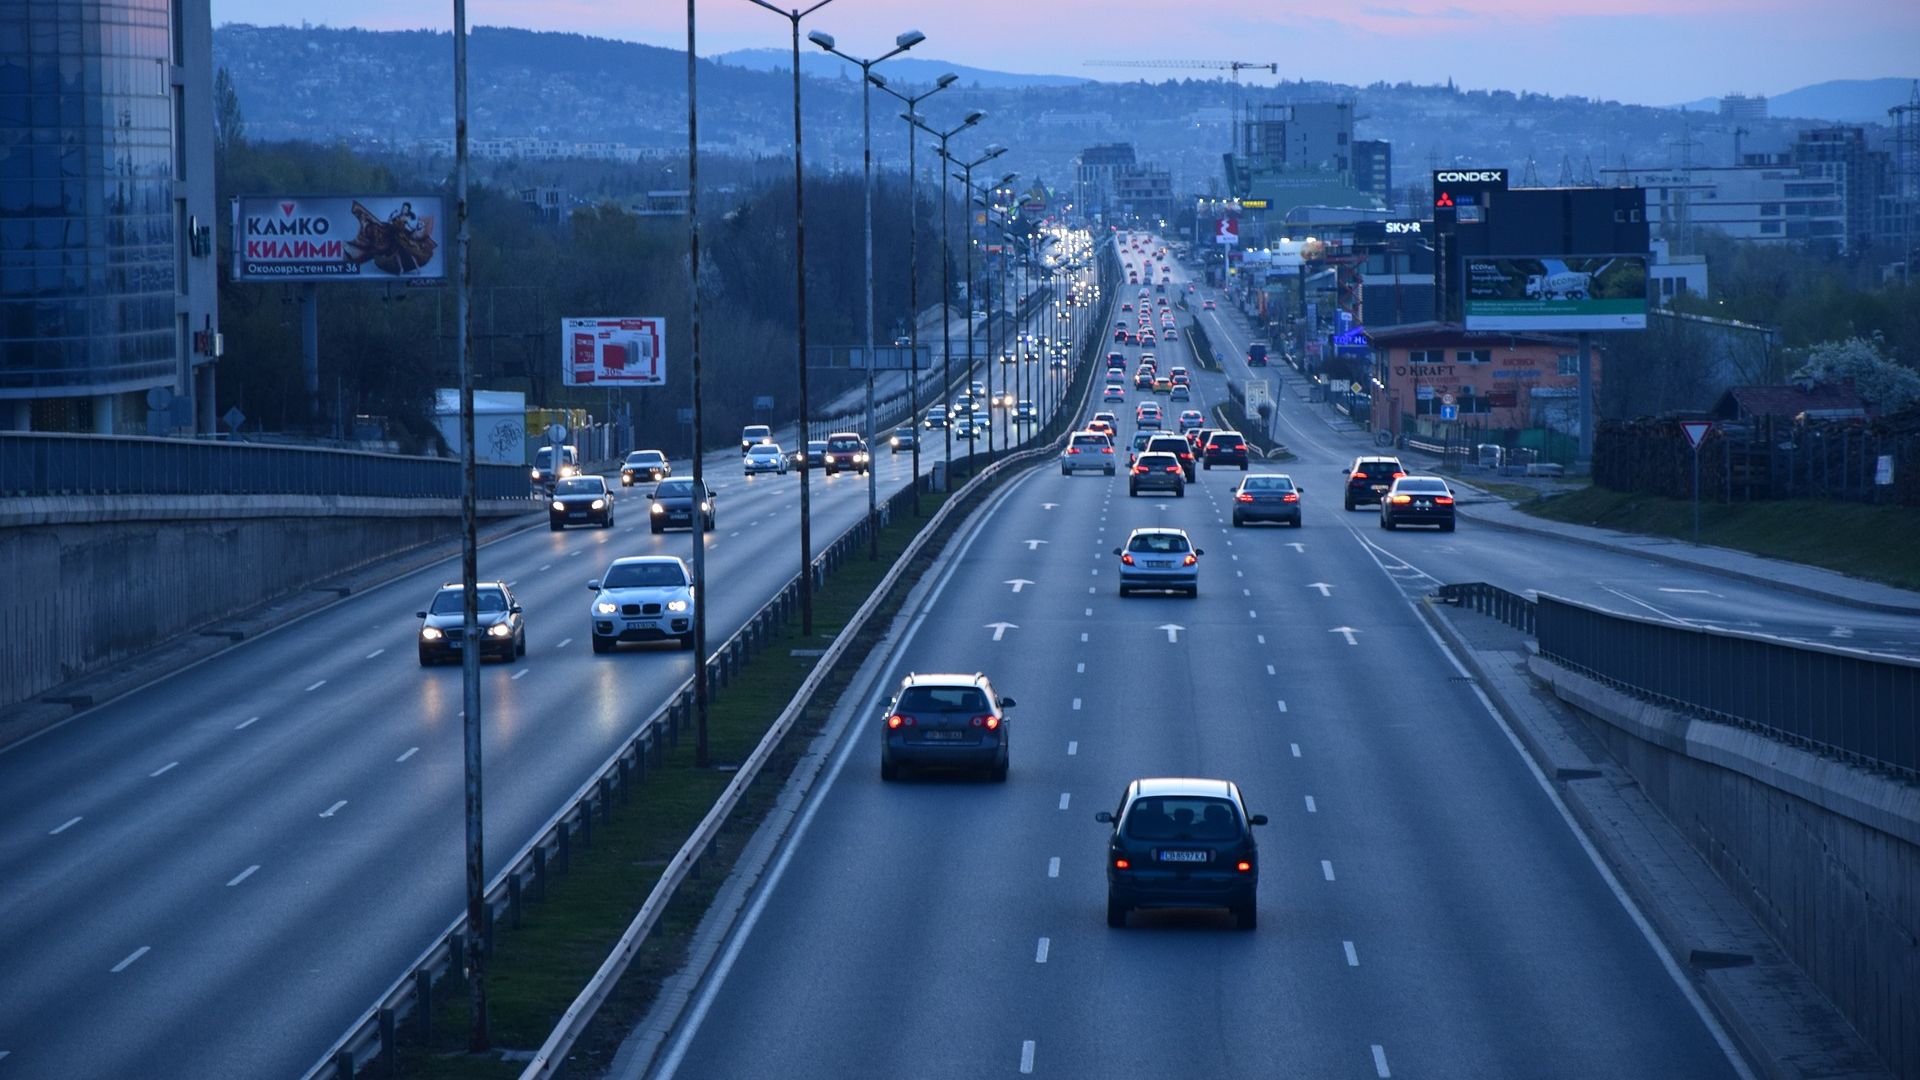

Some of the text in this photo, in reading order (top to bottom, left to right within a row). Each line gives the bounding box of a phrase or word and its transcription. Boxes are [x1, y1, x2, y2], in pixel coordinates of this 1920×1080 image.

[1437, 171, 1501, 182] CONDEX
[248, 217, 329, 235] КАМКО
[248, 240, 342, 258] КИЛИМИ
[248, 263, 357, 275] Околовръстен път 36
[1410, 365, 1456, 376] KRAFT
